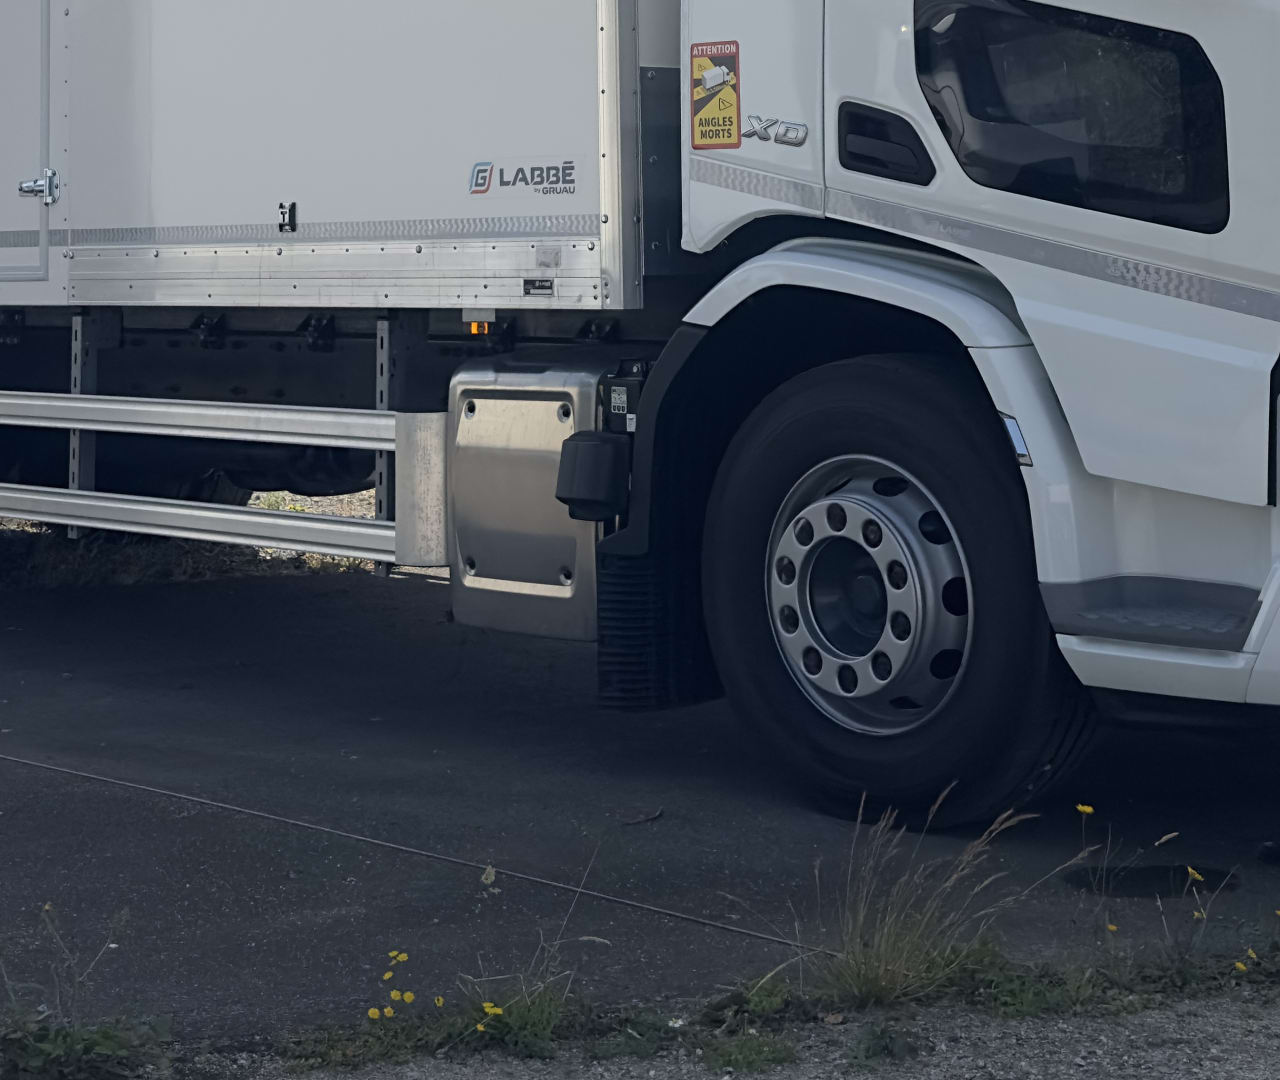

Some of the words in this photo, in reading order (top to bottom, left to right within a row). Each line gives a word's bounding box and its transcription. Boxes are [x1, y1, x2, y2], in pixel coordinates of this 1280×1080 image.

[693, 44, 736, 56] ATTENTION
[698, 116, 733, 128] ANGLES
[700, 128, 732, 140] MORTS
[742, 115, 809, 147] XD
[499, 160, 575, 186] LABBÉ
[542, 185, 576, 195] GRUAU
